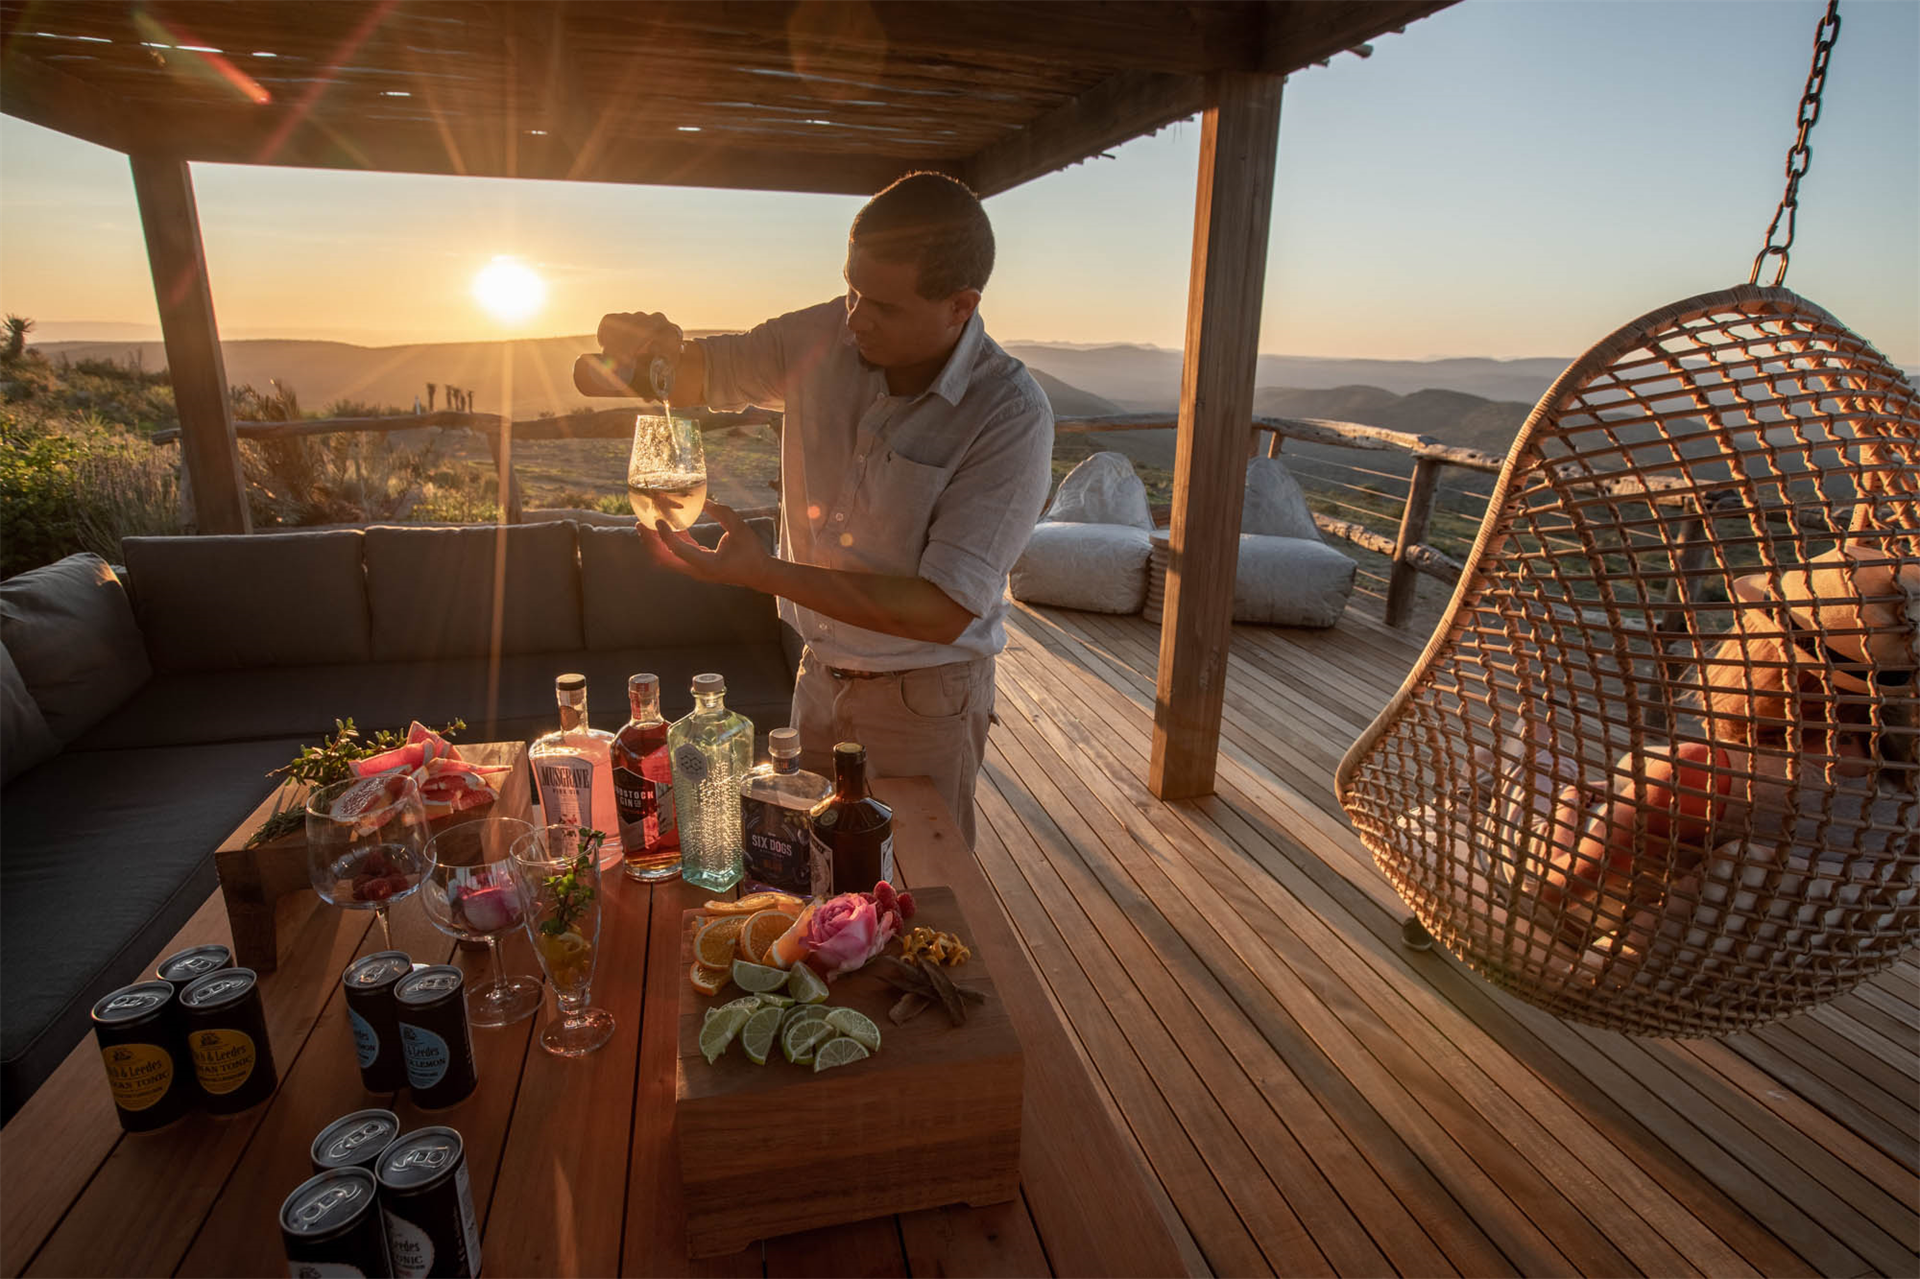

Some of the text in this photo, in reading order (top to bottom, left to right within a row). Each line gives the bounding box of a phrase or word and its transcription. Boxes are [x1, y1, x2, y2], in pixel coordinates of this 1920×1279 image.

[541, 766, 591, 789] MUSGRAVE
[620, 798, 634, 808] GIN
[751, 834, 769, 850] SIX
[769, 838, 792, 857] DOGS
[215, 1043, 247, 1061] Leedes
[129, 1059, 163, 1076] Leedes
[221, 1054, 254, 1072] TONIC
[415, 1058, 446, 1068] LEMON
[137, 1070, 170, 1088] TONIC
